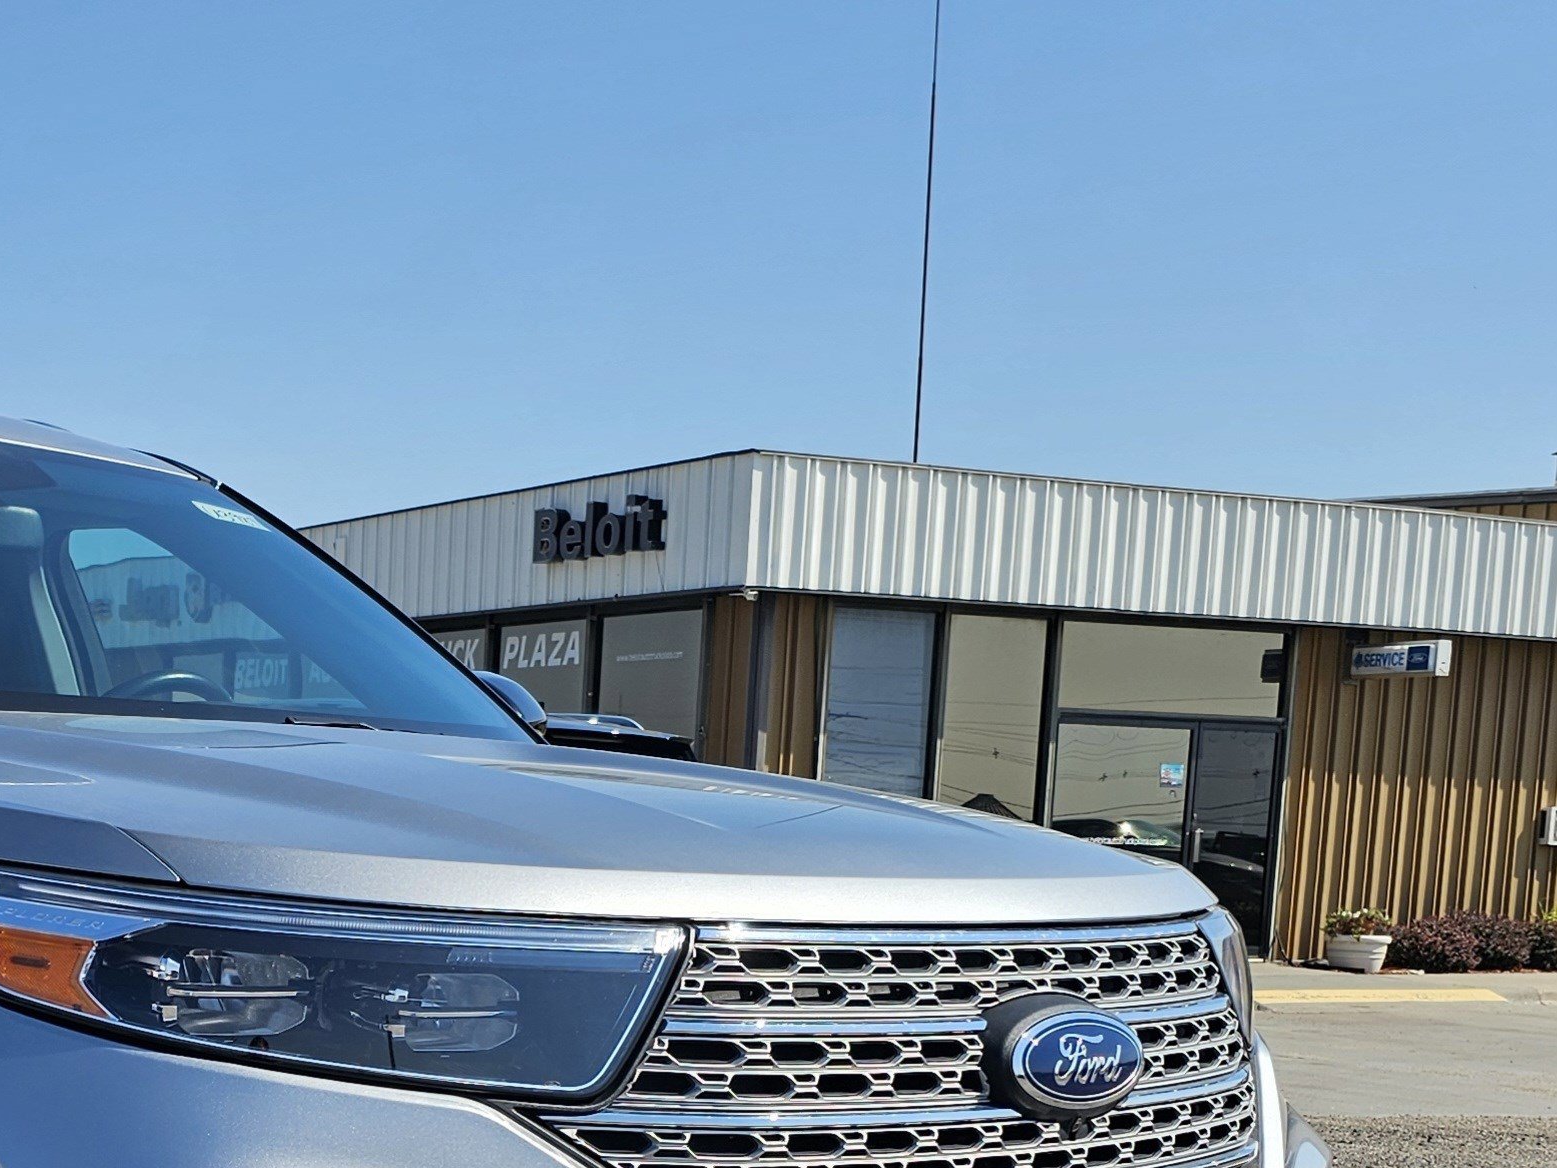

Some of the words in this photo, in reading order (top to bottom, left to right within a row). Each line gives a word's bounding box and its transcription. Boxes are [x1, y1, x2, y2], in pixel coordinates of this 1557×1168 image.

[532, 494, 662, 564] Beloit
[503, 630, 580, 669] PLAZA
[1364, 652, 1405, 668] SERVICE
[234, 658, 289, 689] BELOIT
[1054, 1033, 1124, 1087] Ford
